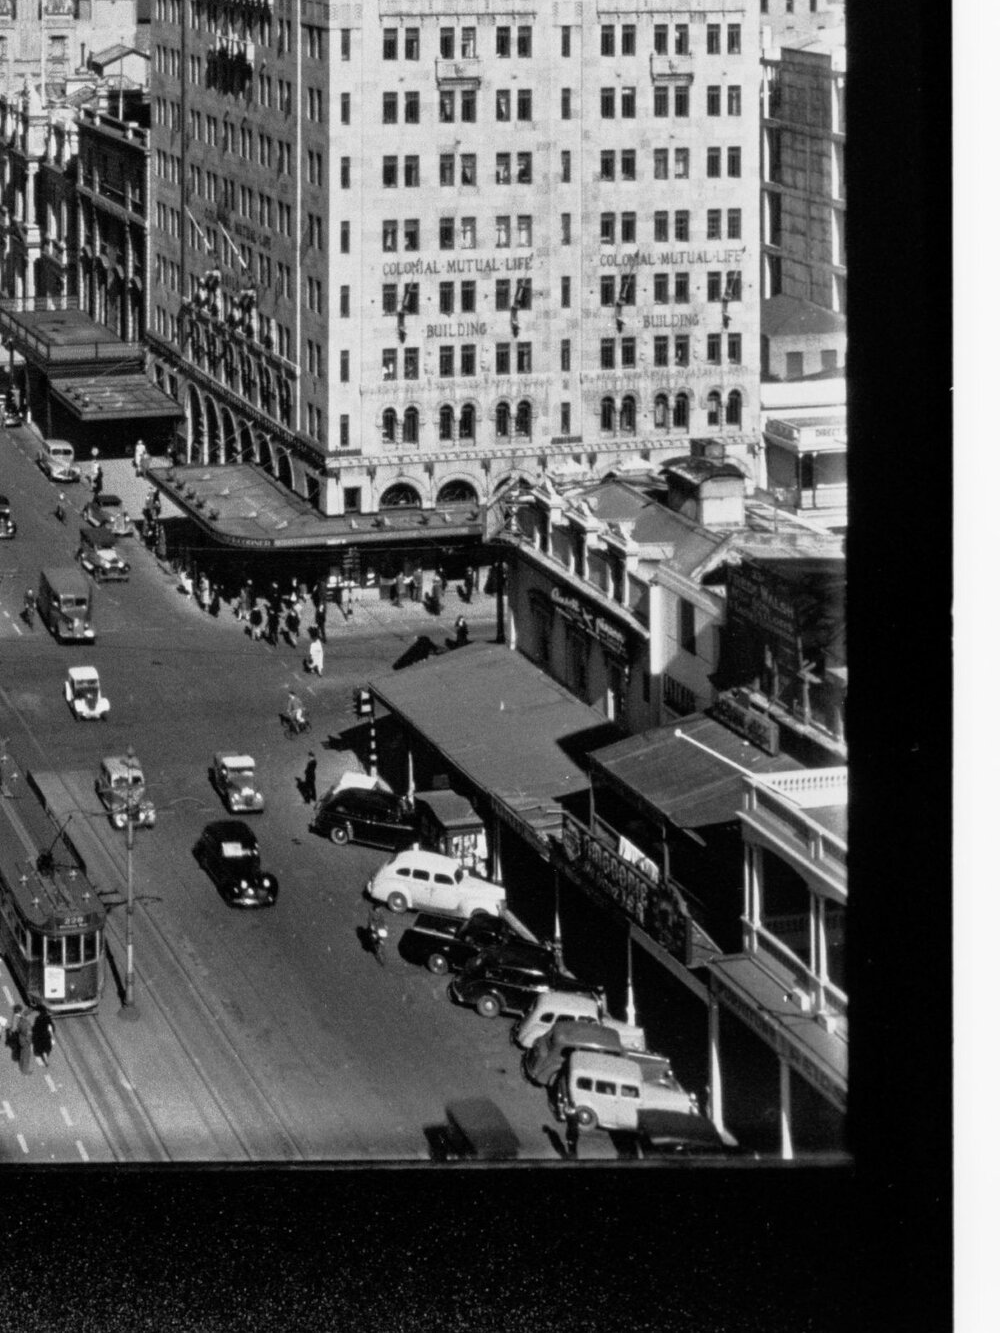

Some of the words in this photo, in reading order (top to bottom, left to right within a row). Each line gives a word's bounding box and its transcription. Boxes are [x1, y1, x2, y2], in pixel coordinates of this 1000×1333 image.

[382, 259, 441, 276] COLONIAL
[446, 257, 500, 273] MUTUAL
[505, 256, 533, 271] LIFE
[600, 252, 656, 267] COLONIAL
[660, 250, 712, 265] MUTUAL
[716, 249, 743, 263] LIFE
[643, 313, 699, 328] BUILDING
[426, 321, 488, 339] BUILDING
